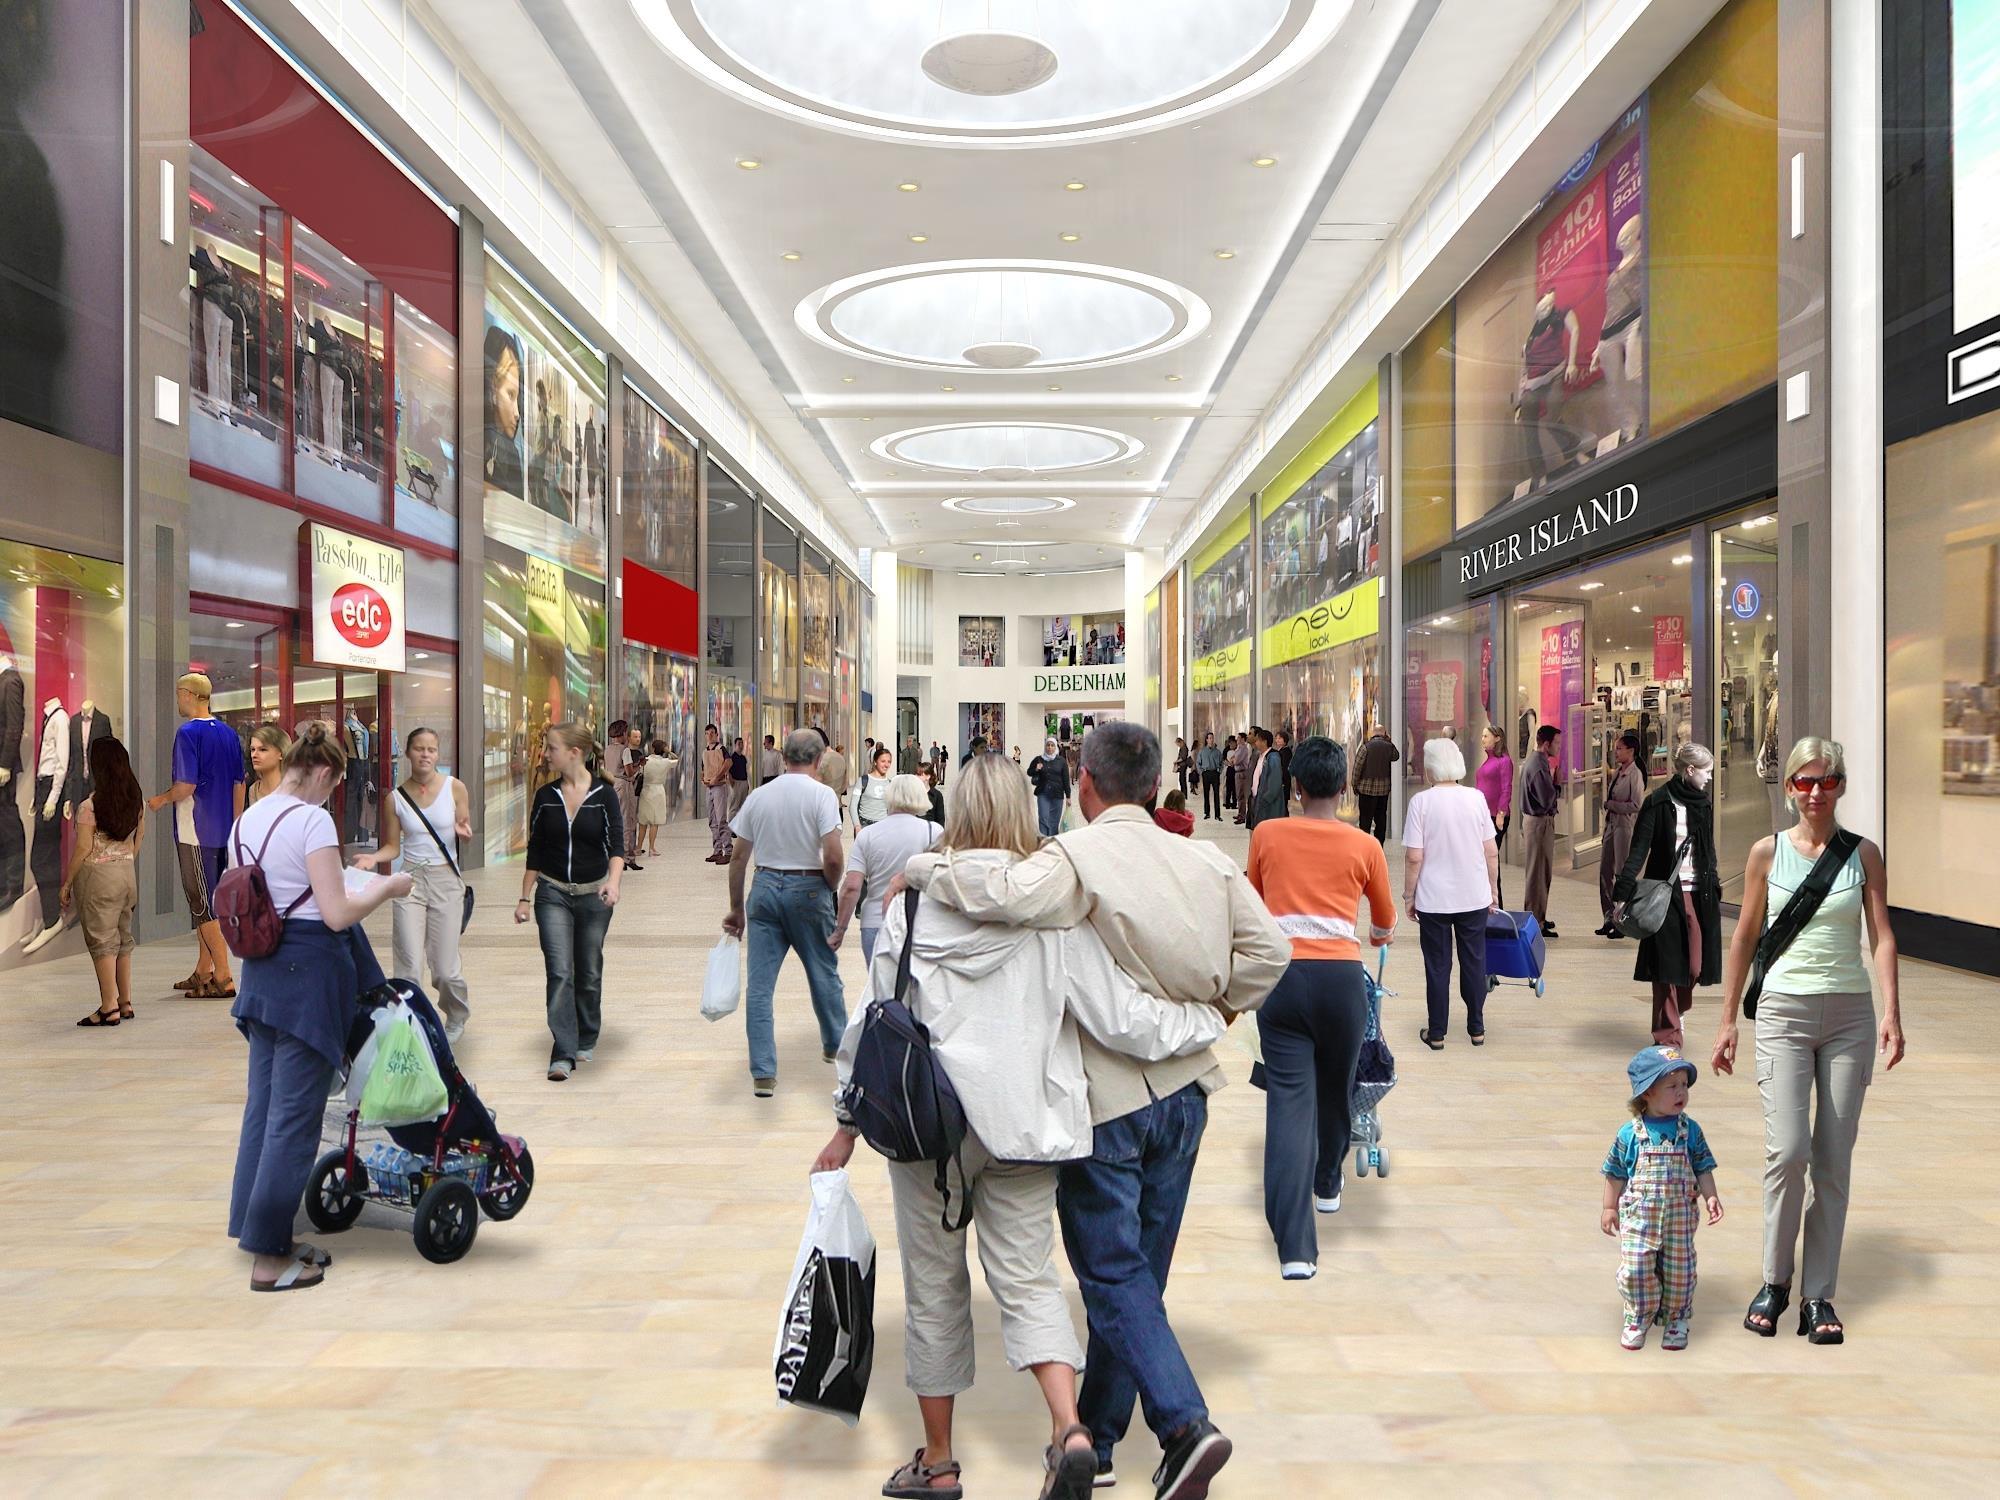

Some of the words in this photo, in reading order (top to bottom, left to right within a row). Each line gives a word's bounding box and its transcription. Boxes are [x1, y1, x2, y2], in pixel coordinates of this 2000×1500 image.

[1460, 534, 1523, 584] RIVER
[1529, 483, 1639, 557] ISLAND
[342, 594, 382, 632] edc
[1290, 592, 1355, 641] new
[1206, 645, 1239, 673] new
[1309, 632, 1329, 650] look
